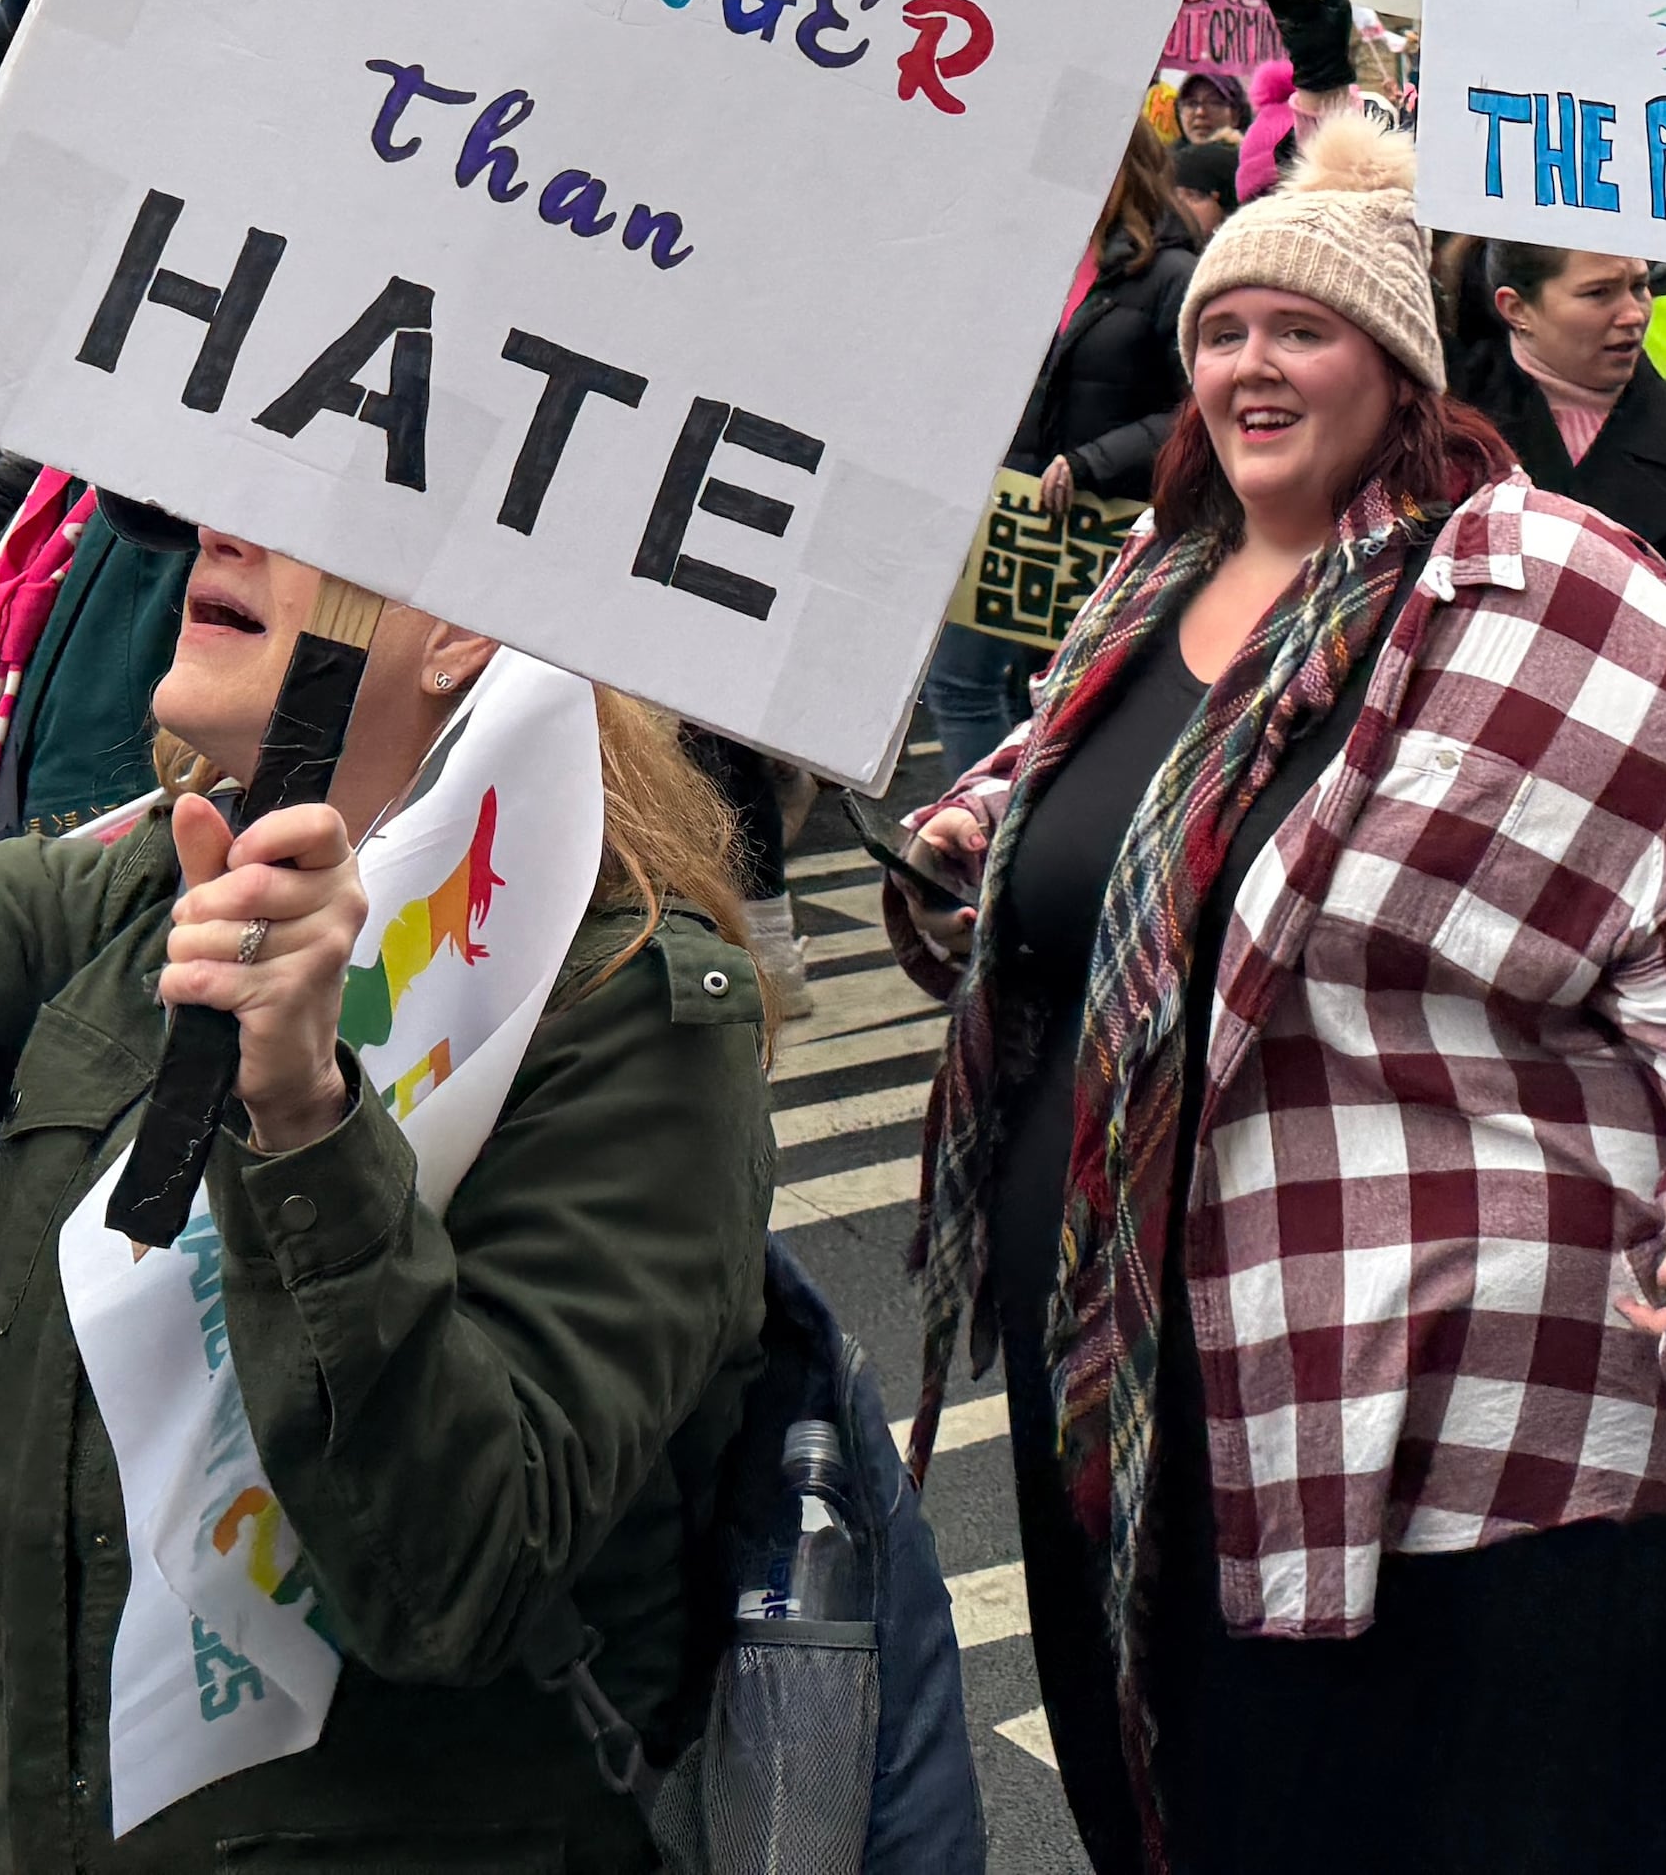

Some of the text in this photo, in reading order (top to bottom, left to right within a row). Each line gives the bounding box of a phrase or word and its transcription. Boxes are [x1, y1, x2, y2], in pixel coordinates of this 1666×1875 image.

[364, 57, 697, 272] than
[1467, 86, 1621, 213] THE
[75, 186, 826, 621] HATE
